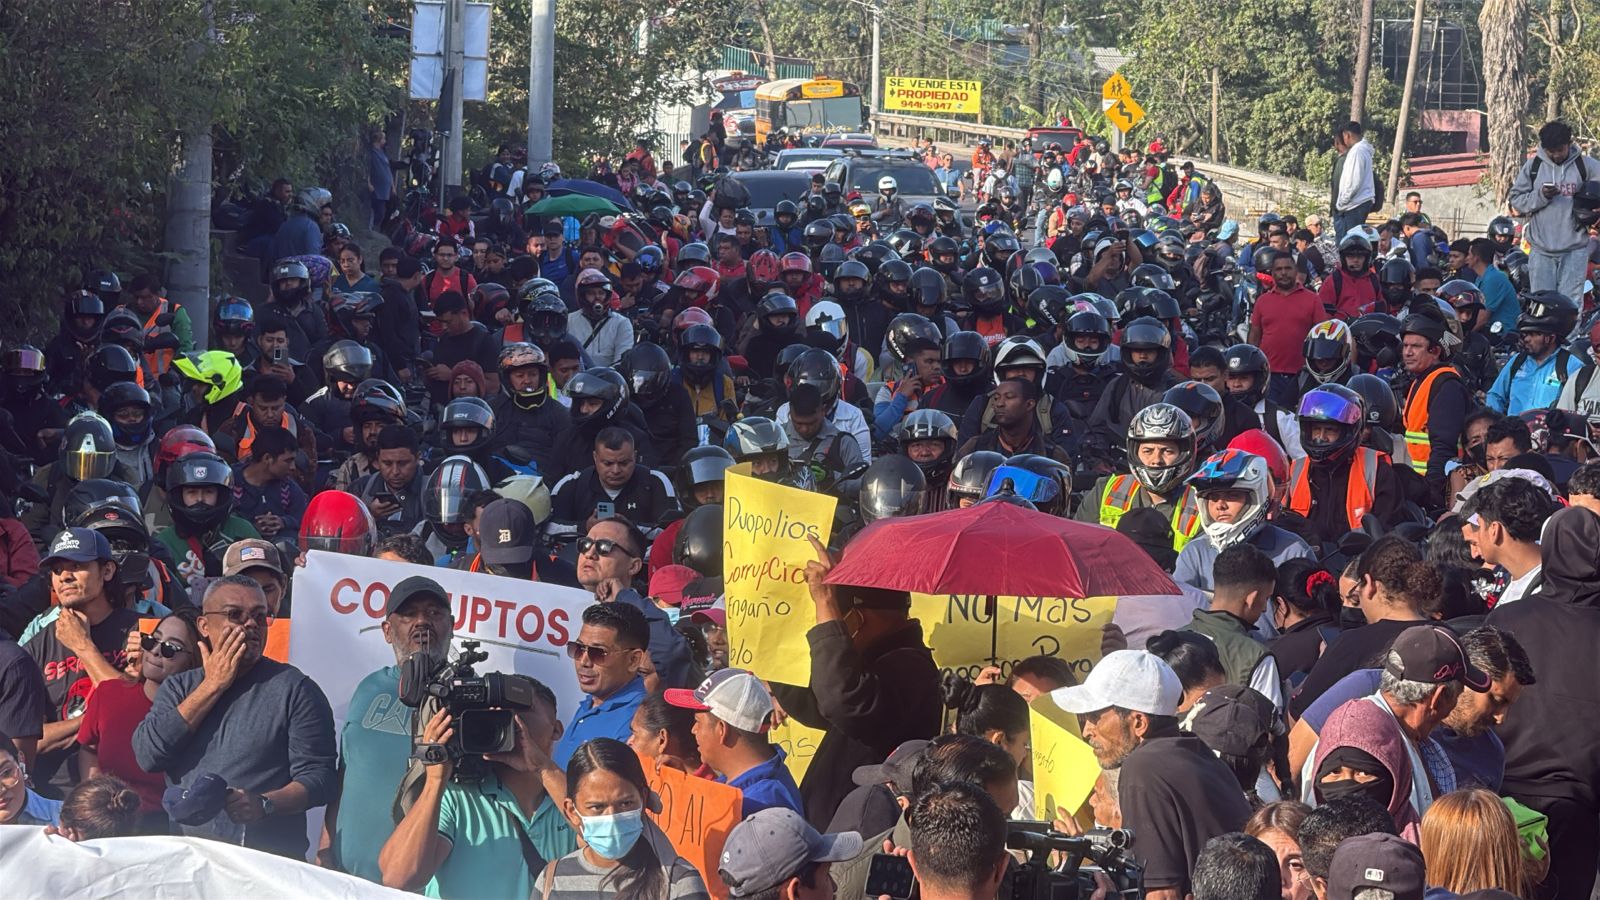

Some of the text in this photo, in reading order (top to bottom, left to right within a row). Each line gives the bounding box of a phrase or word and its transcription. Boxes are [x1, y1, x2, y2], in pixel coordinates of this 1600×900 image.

[889, 78, 977, 92] SE VENDE ESTA
[897, 89, 969, 102] PROPIEDAD
[900, 100, 952, 110] 9441-5947
[728, 496, 820, 544] Duopolios
[330, 577, 570, 647] COUPTOS
[728, 595, 791, 627] Engaño
